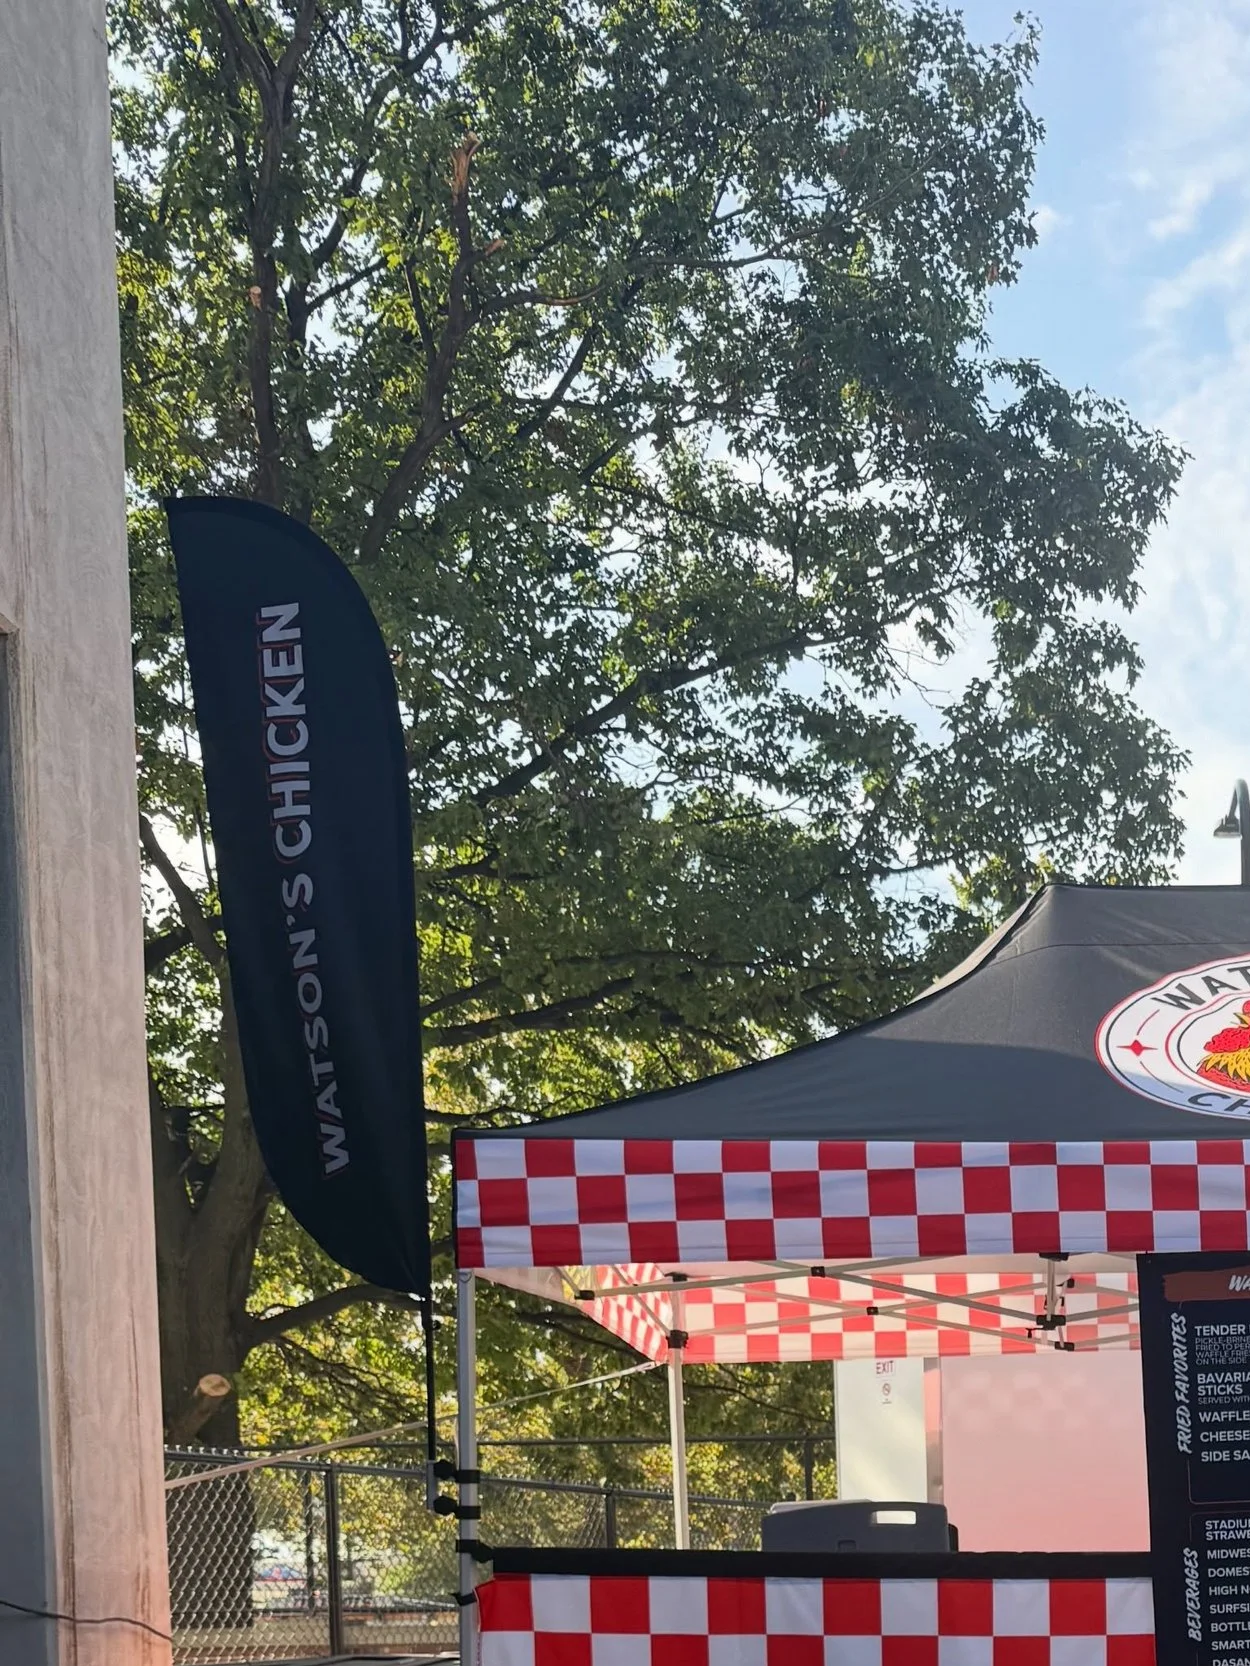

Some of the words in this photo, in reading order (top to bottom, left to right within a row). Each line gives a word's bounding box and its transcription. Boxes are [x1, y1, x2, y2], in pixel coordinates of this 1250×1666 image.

[257, 601, 313, 860] CHICKEN
[281, 872, 352, 1178] WATSON'S
[1194, 1324, 1246, 1337] TENDER
[1195, 1343, 1221, 1351] FRIED
[1170, 1312, 1190, 1404] FAVORITES
[1195, 1350, 1229, 1359] WAFFLE
[1196, 1358, 1209, 1366] ON
[1211, 1357, 1227, 1365] THE
[1228, 1356, 1247, 1364] SIDE
[1197, 1384, 1243, 1396] STICKS
[1198, 1396, 1231, 1405] SERVED
[1199, 1410, 1250, 1423] WAFFLE
[1176, 1404, 1193, 1455] FRIED
[1200, 1430, 1250, 1443] CHEESE
[1201, 1451, 1230, 1462] SIDE
[1183, 1547, 1202, 1642] BEVERAGES
[1208, 1585, 1238, 1596] HIGH
[1211, 1639, 1250, 1651] SMART
